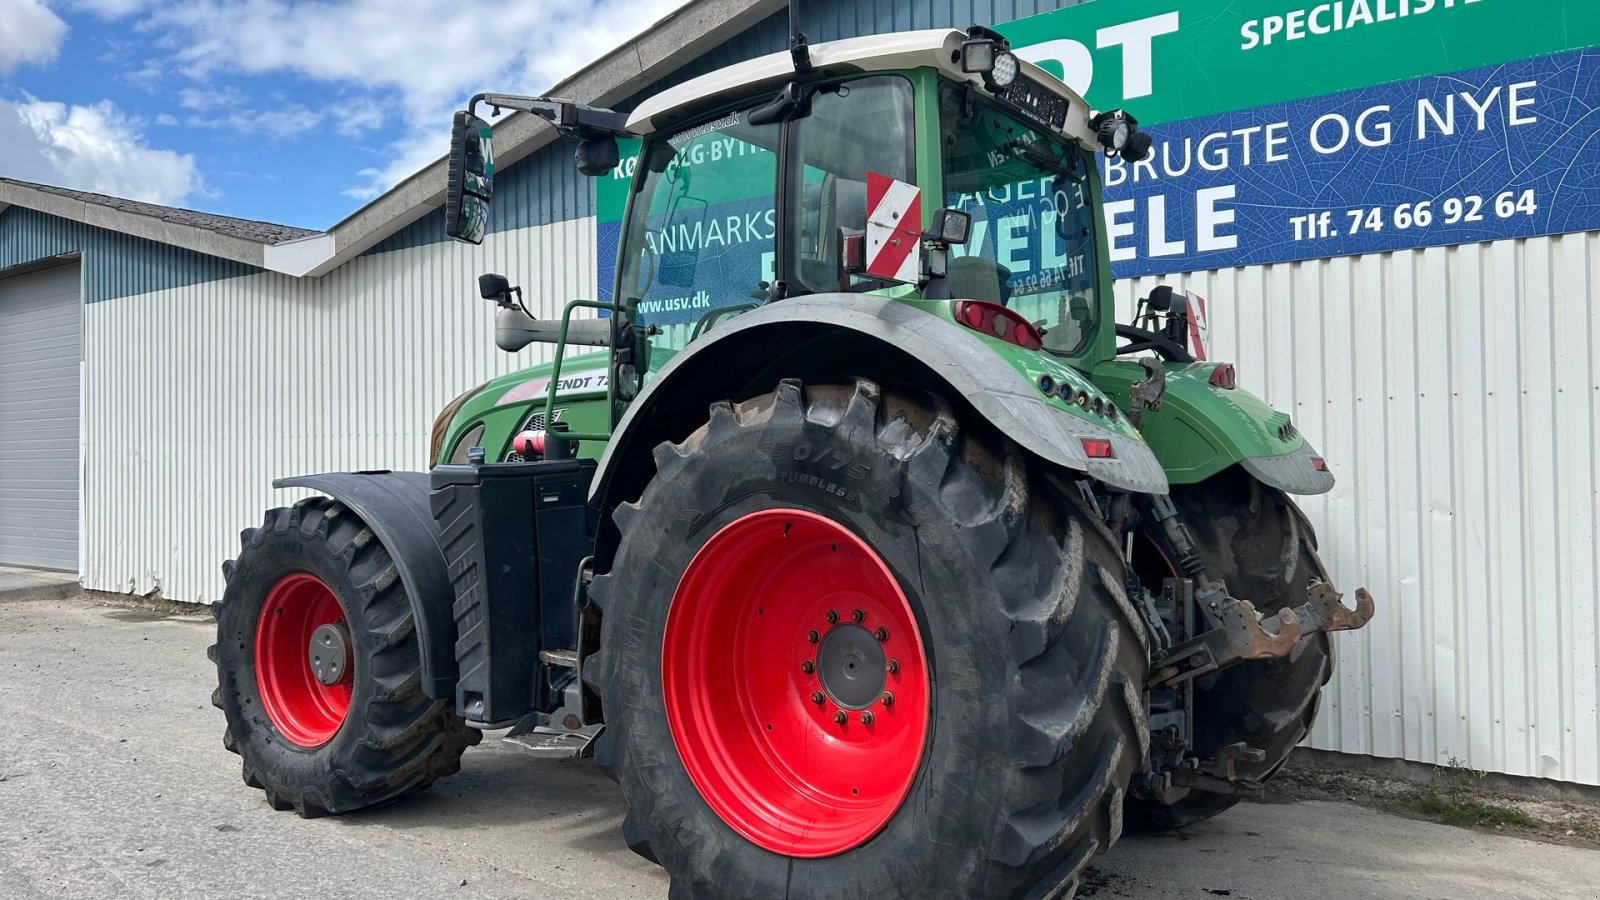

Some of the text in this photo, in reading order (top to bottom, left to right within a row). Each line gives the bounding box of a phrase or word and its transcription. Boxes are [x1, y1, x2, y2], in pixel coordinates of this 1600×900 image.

[641, 208, 776, 258] ANMARKS
[1104, 121, 1289, 187] BRUGTE
[1309, 105, 1392, 155] OG
[1416, 80, 1538, 140] NYE
[1289, 188, 1537, 241] Tlf. 74 66 92 64
